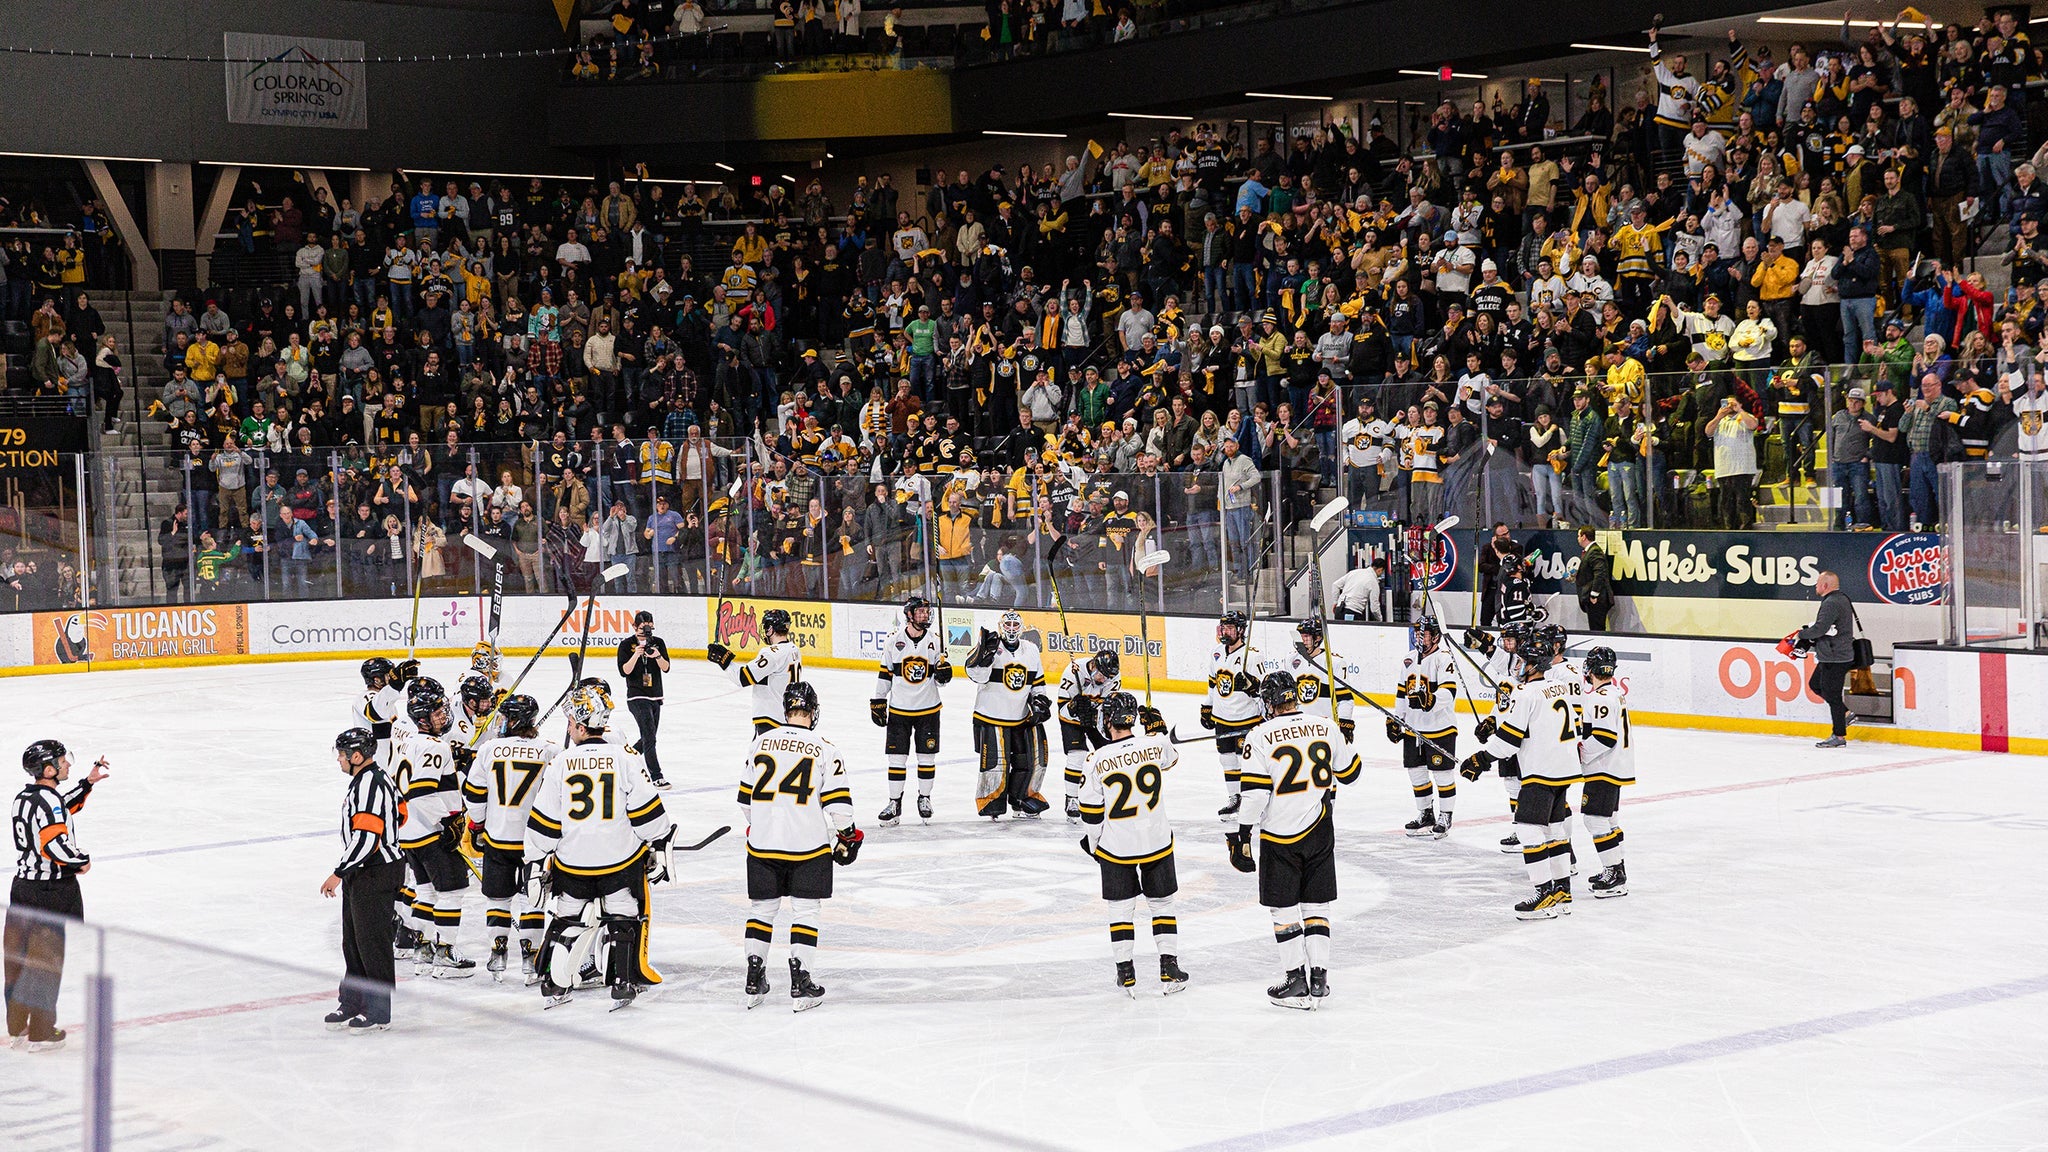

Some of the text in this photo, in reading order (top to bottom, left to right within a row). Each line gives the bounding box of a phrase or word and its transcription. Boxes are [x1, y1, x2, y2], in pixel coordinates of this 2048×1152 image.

[253, 75, 343, 97] COLORADO
[273, 91, 326, 107] SPRINGS
[261, 107, 338, 120] OLYMPIC CITY USA
[499, 213, 514, 226] 99
[1894, 537, 1912, 548] SINCE
[1611, 539, 1717, 584] Mike's
[1725, 544, 1821, 586] SUBS
[492, 562, 504, 616] BAUER
[1908, 588, 1934, 603] SUBS
[111, 608, 217, 641] TUCANOS
[236, 604, 244, 655] OFFICIAL SPONSOR
[718, 600, 762, 649] Rudy's
[791, 611, 827, 630] TEXAS
[947, 617, 972, 625] URBAN
[271, 620, 449, 647] CommonSpirit
[1047, 631, 1163, 657] Black Bear Diner
[112, 637, 219, 660] BRAZILIAN GRILL
[755, 654, 769, 669] 10
[1445, 662, 1455, 674] 4
[1060, 678, 1074, 691] 27
[1568, 682, 1582, 696] 18
[1593, 705, 1609, 719] 19
[493, 746, 544, 760] COFFEY
[760, 738, 822, 759] EINBERGS
[422, 753, 443, 769] 20
[566, 757, 615, 772] WILDER
[1096, 747, 1164, 776] MONTGOMERY
[1270, 740, 1333, 797] 28
[491, 760, 545, 808] 17
[751, 752, 816, 806] 24
[565, 771, 616, 822] 31
[1102, 763, 1163, 821] 29
